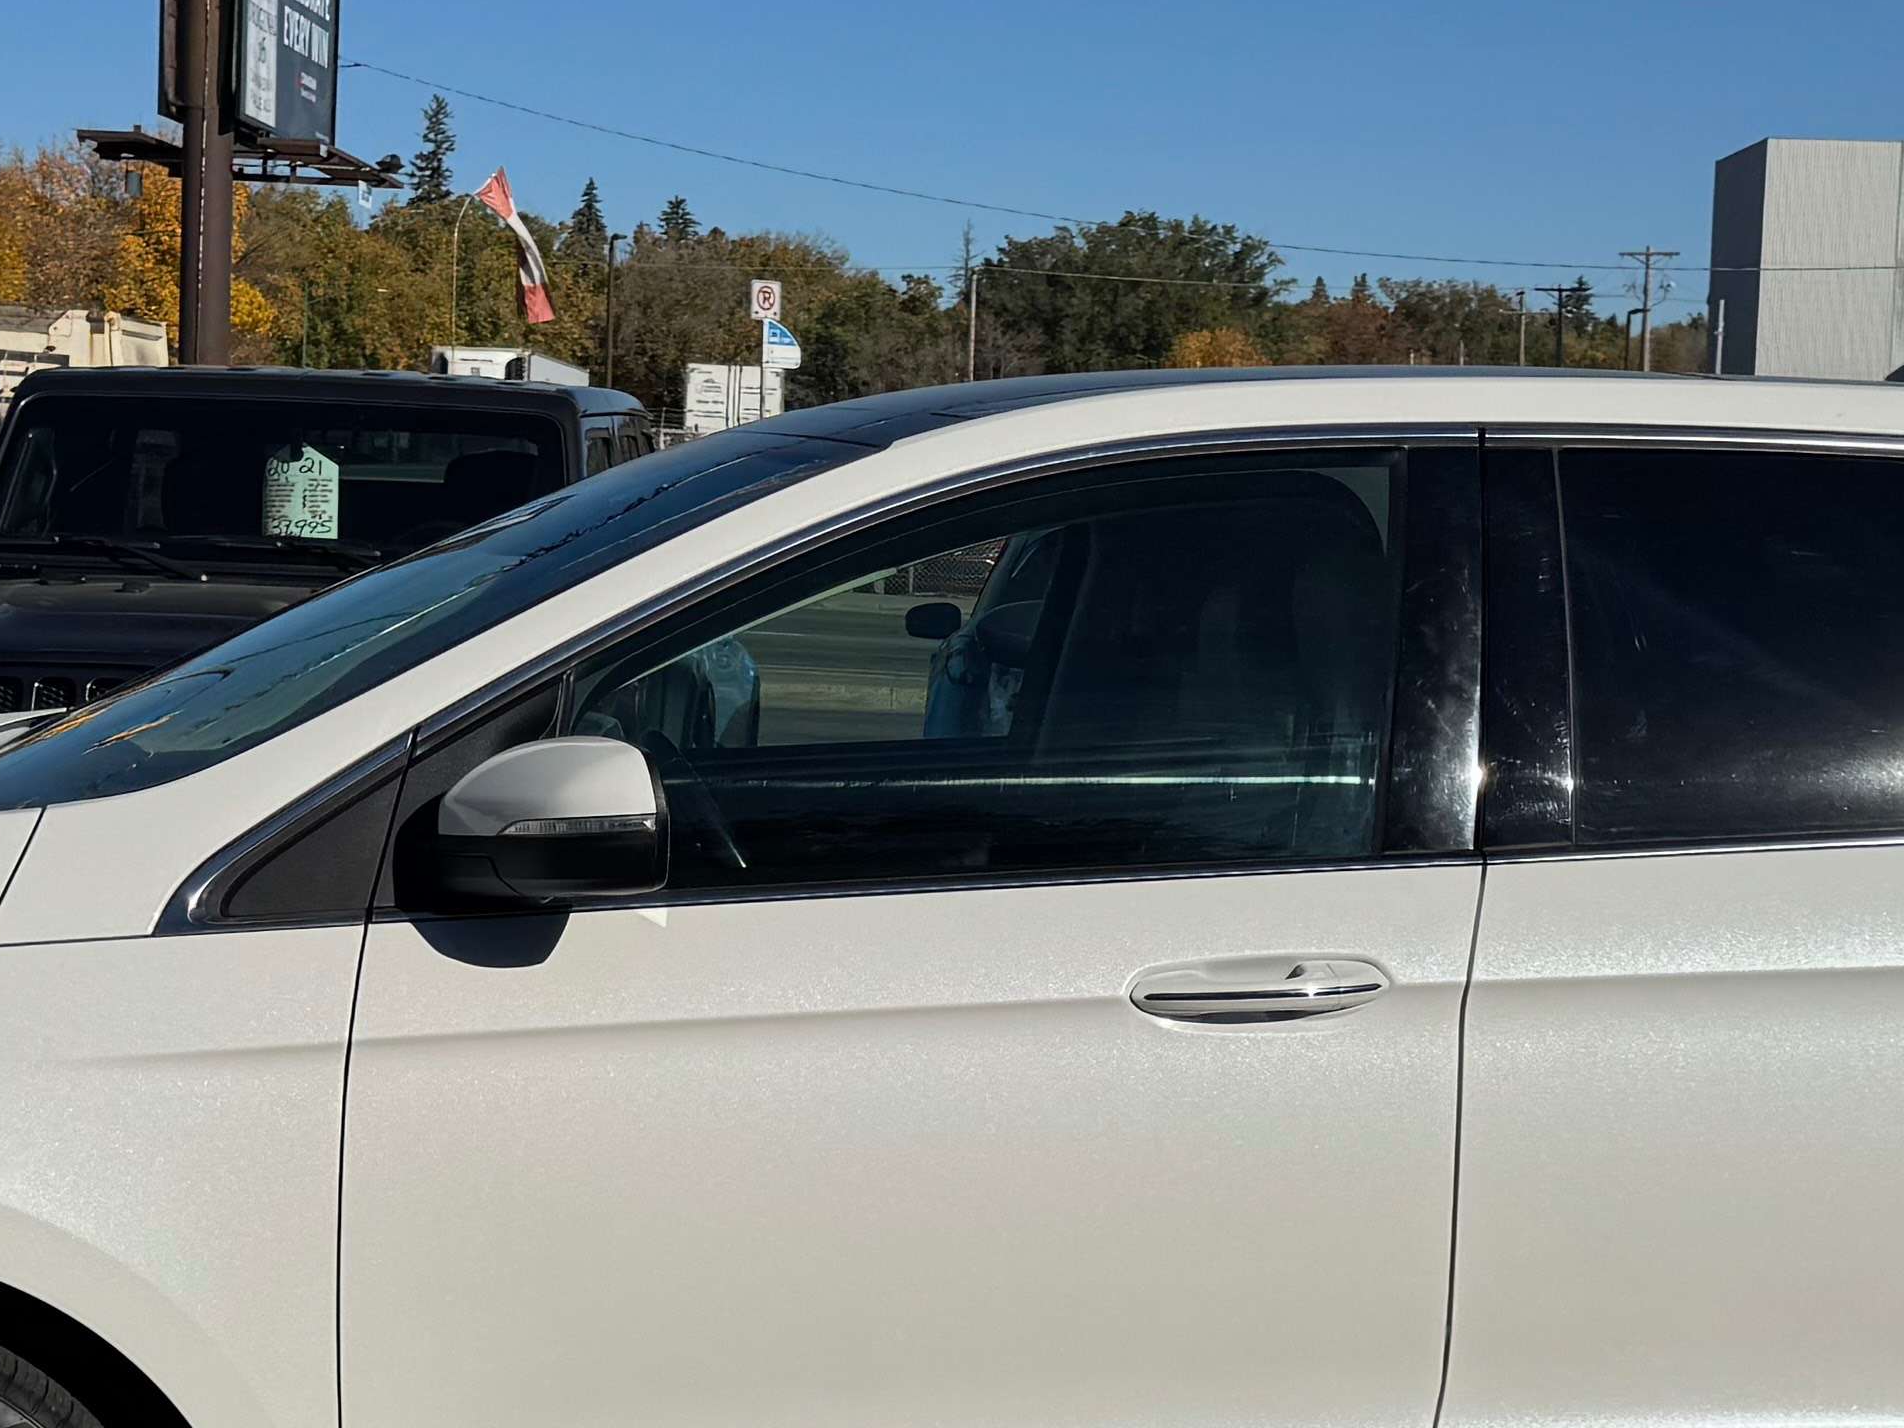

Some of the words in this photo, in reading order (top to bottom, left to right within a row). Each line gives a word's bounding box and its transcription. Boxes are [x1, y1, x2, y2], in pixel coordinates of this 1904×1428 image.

[282, 4, 311, 58] EVERY
[311, 22, 329, 68] WIN
[298, 456, 323, 477] 21
